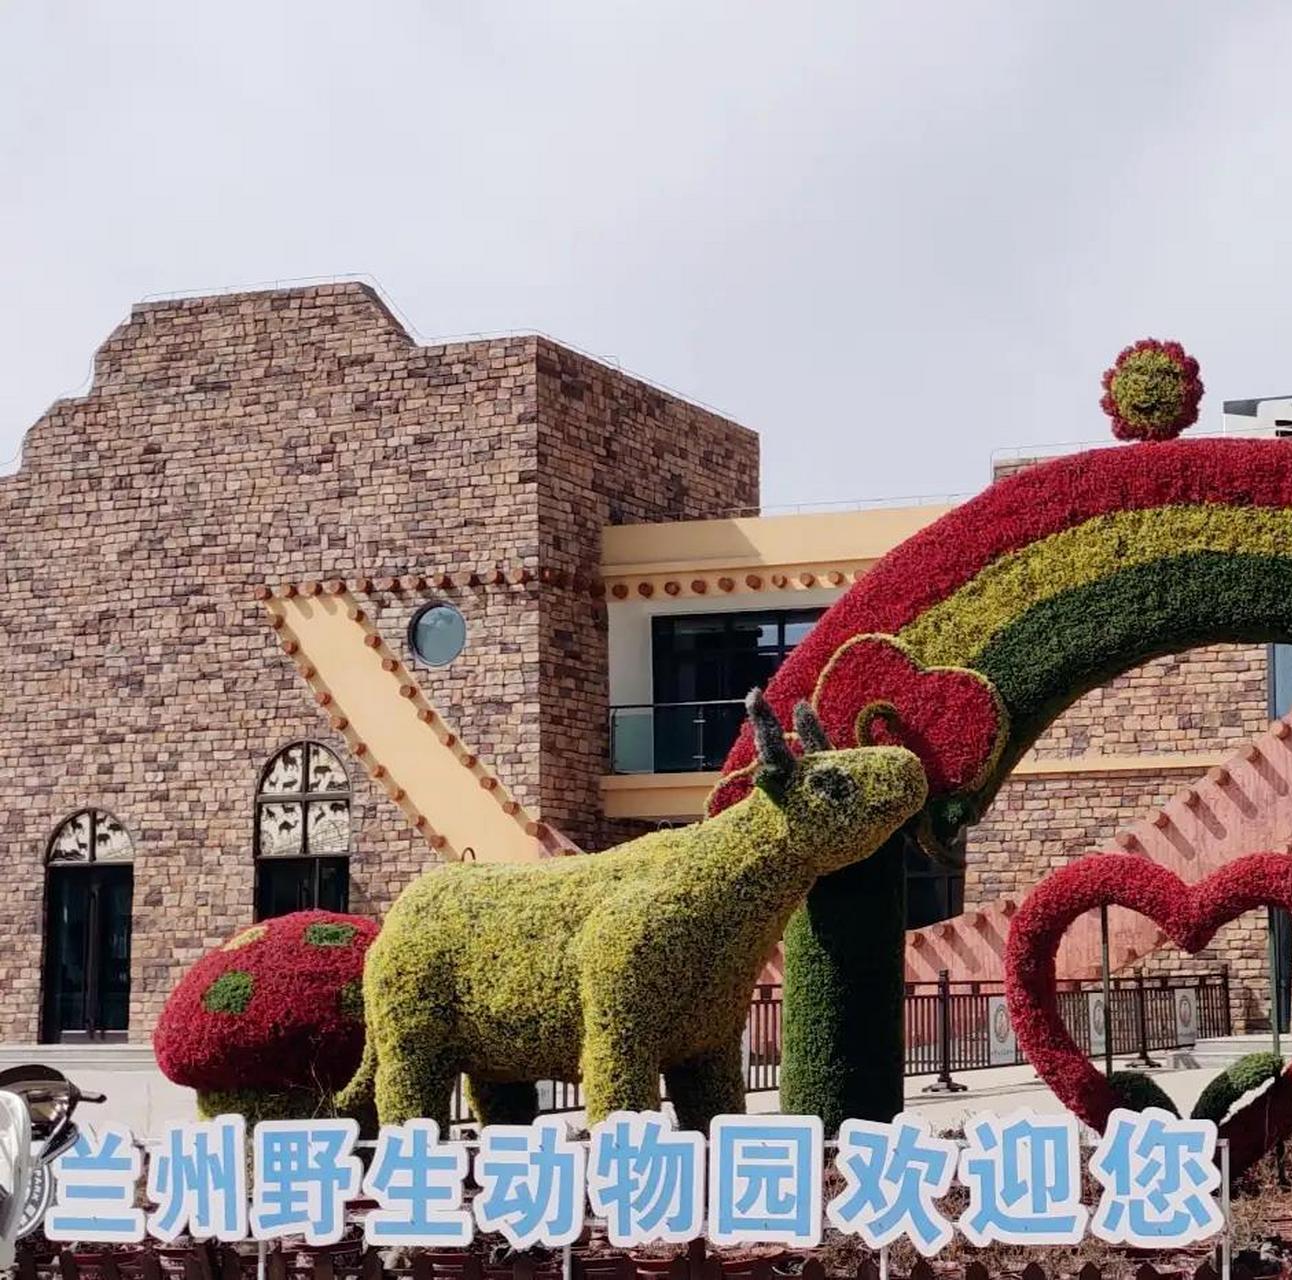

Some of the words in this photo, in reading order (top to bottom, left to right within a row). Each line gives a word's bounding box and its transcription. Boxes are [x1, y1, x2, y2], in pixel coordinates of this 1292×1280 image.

[53, 1121, 1214, 1239] 兰州野生动物园欢迎您
